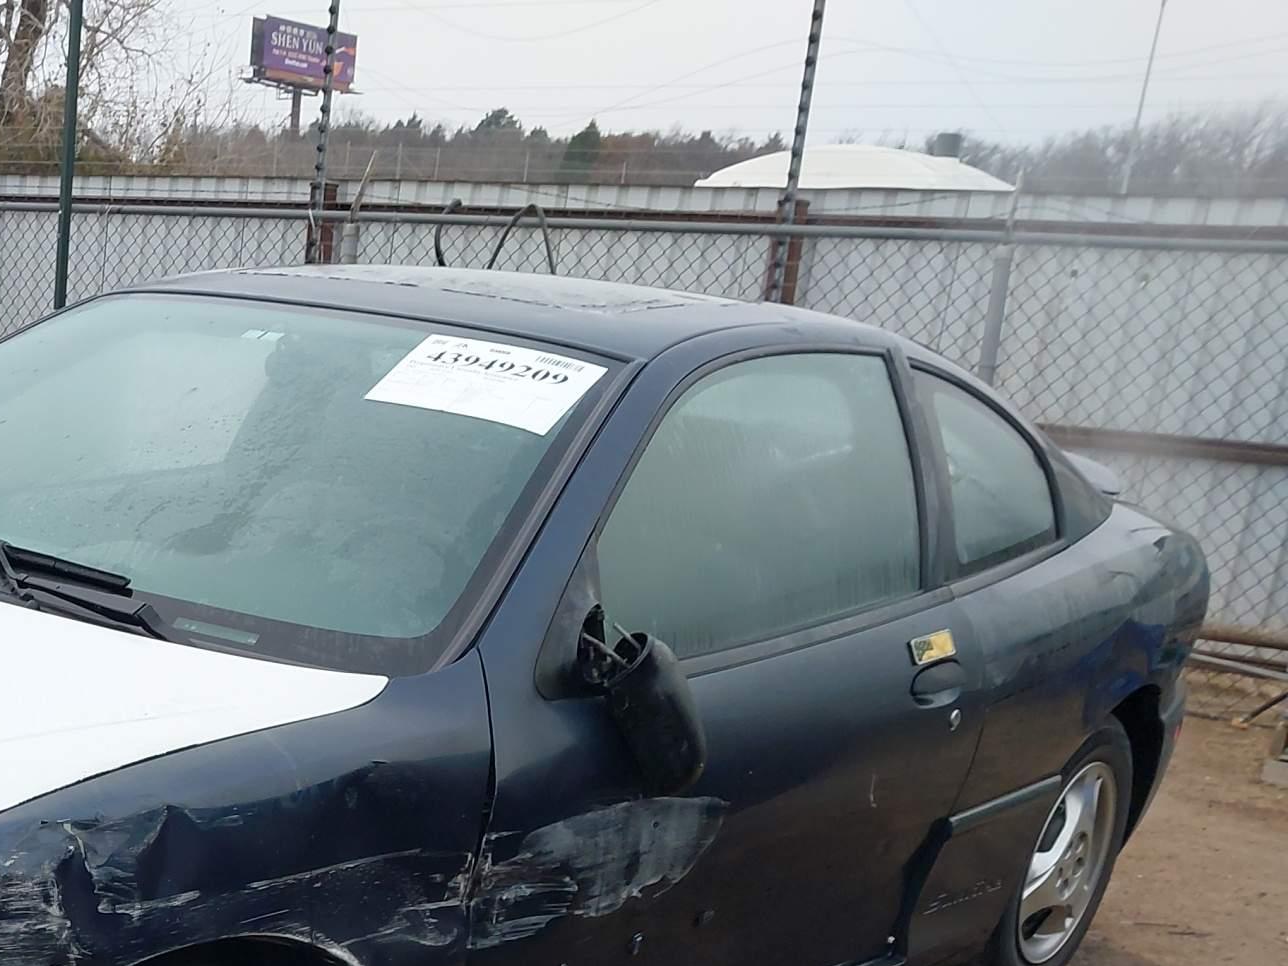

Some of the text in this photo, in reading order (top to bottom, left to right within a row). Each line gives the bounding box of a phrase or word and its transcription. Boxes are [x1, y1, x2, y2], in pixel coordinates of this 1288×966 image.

[271, 31, 300, 49] SHEN
[302, 38, 324, 55] YUN
[426, 350, 569, 385] 43949209
